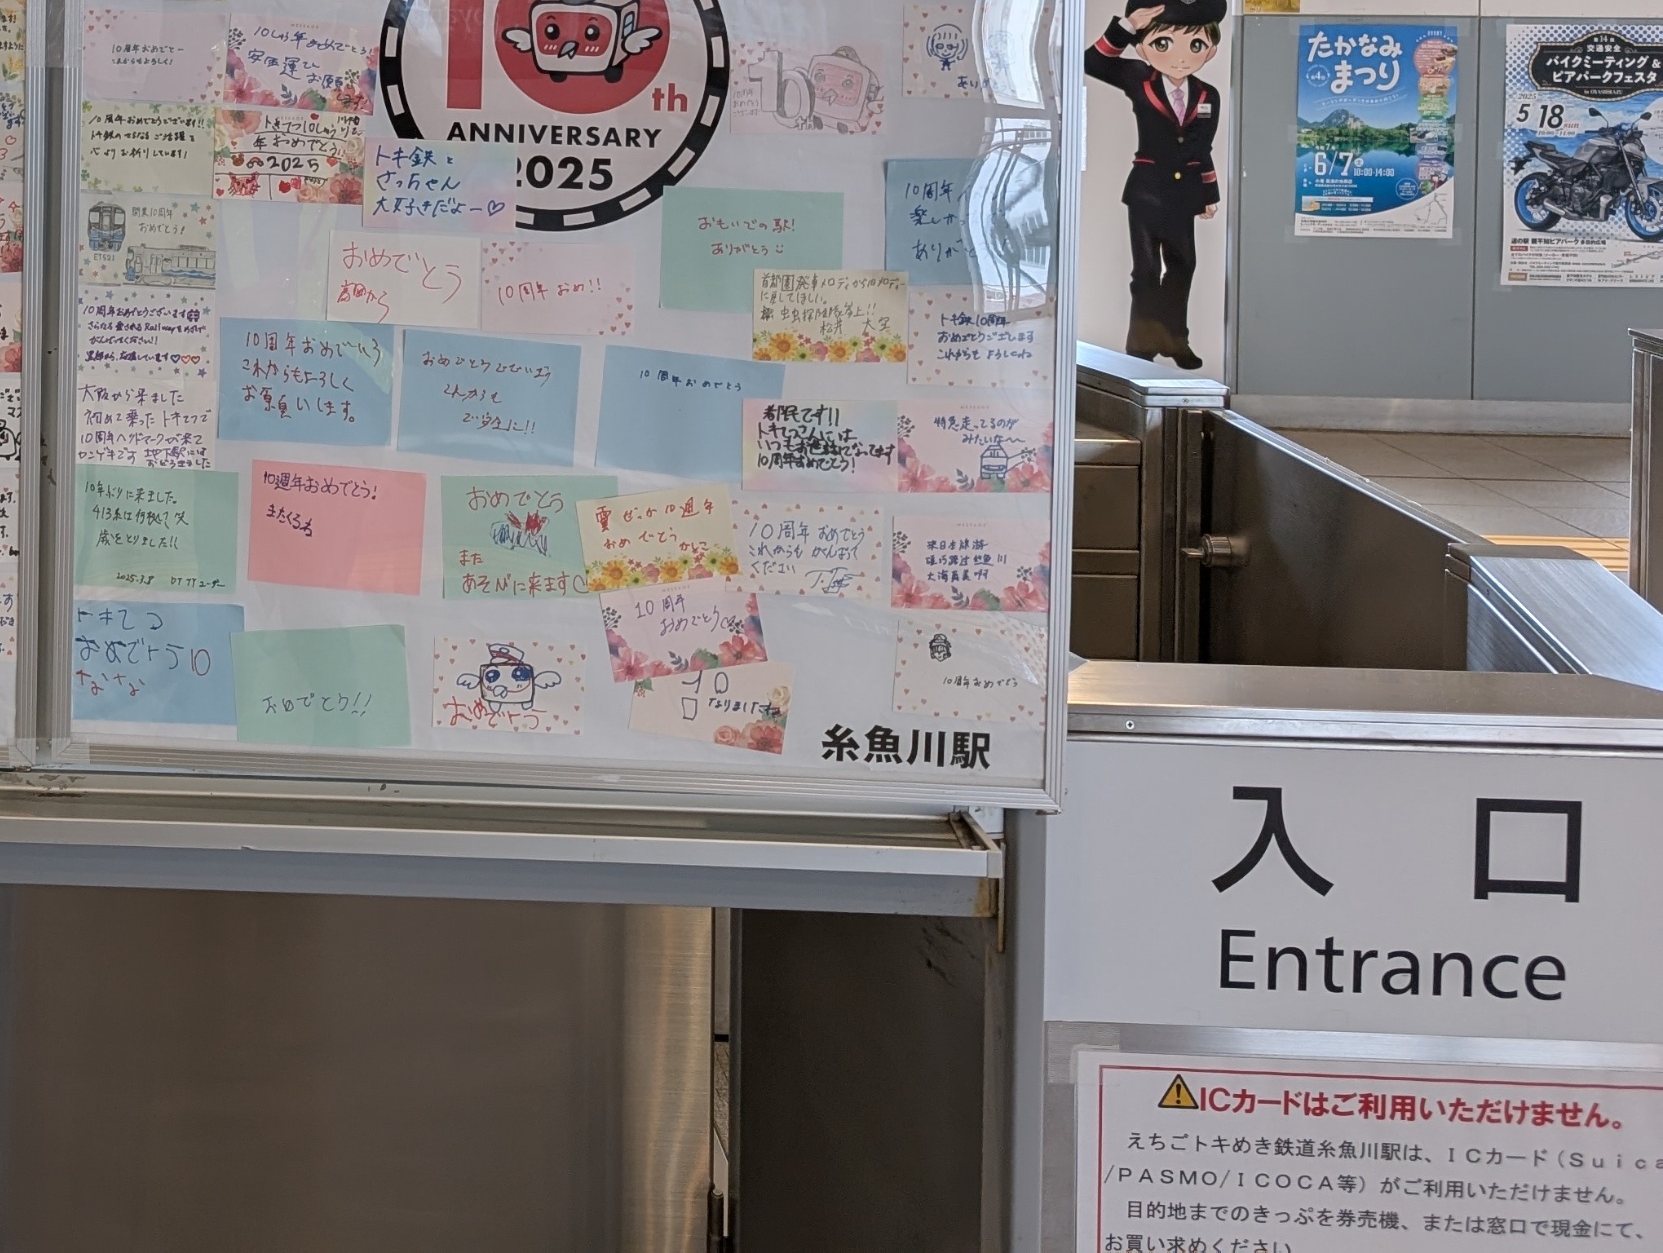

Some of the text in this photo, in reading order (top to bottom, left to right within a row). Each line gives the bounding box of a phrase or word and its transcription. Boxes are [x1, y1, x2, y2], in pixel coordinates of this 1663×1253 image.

[1308, 31, 1403, 62] たかなみ
[1546, 55, 1661, 69] バイクミーティング &
[1331, 60, 1400, 94] まつり
[1552, 71, 1657, 84] ピアパークフェスタ
[1516, 104, 1564, 128] 5 18
[447, 121, 662, 149] ANNIVERSARY
[266, 158, 320, 172] 2025
[516, 155, 614, 190] 025
[1315, 151, 1353, 176] 6/7
[822, 724, 991, 769] 糸魚川駅
[1219, 929, 1567, 1001] Entrance
[1199, 1087, 1622, 1130] ICカードはご利用いただけません。
[1127, 1200, 1643, 1239] 目的地までのきっぷを券売機、または窓口で現金にて、
